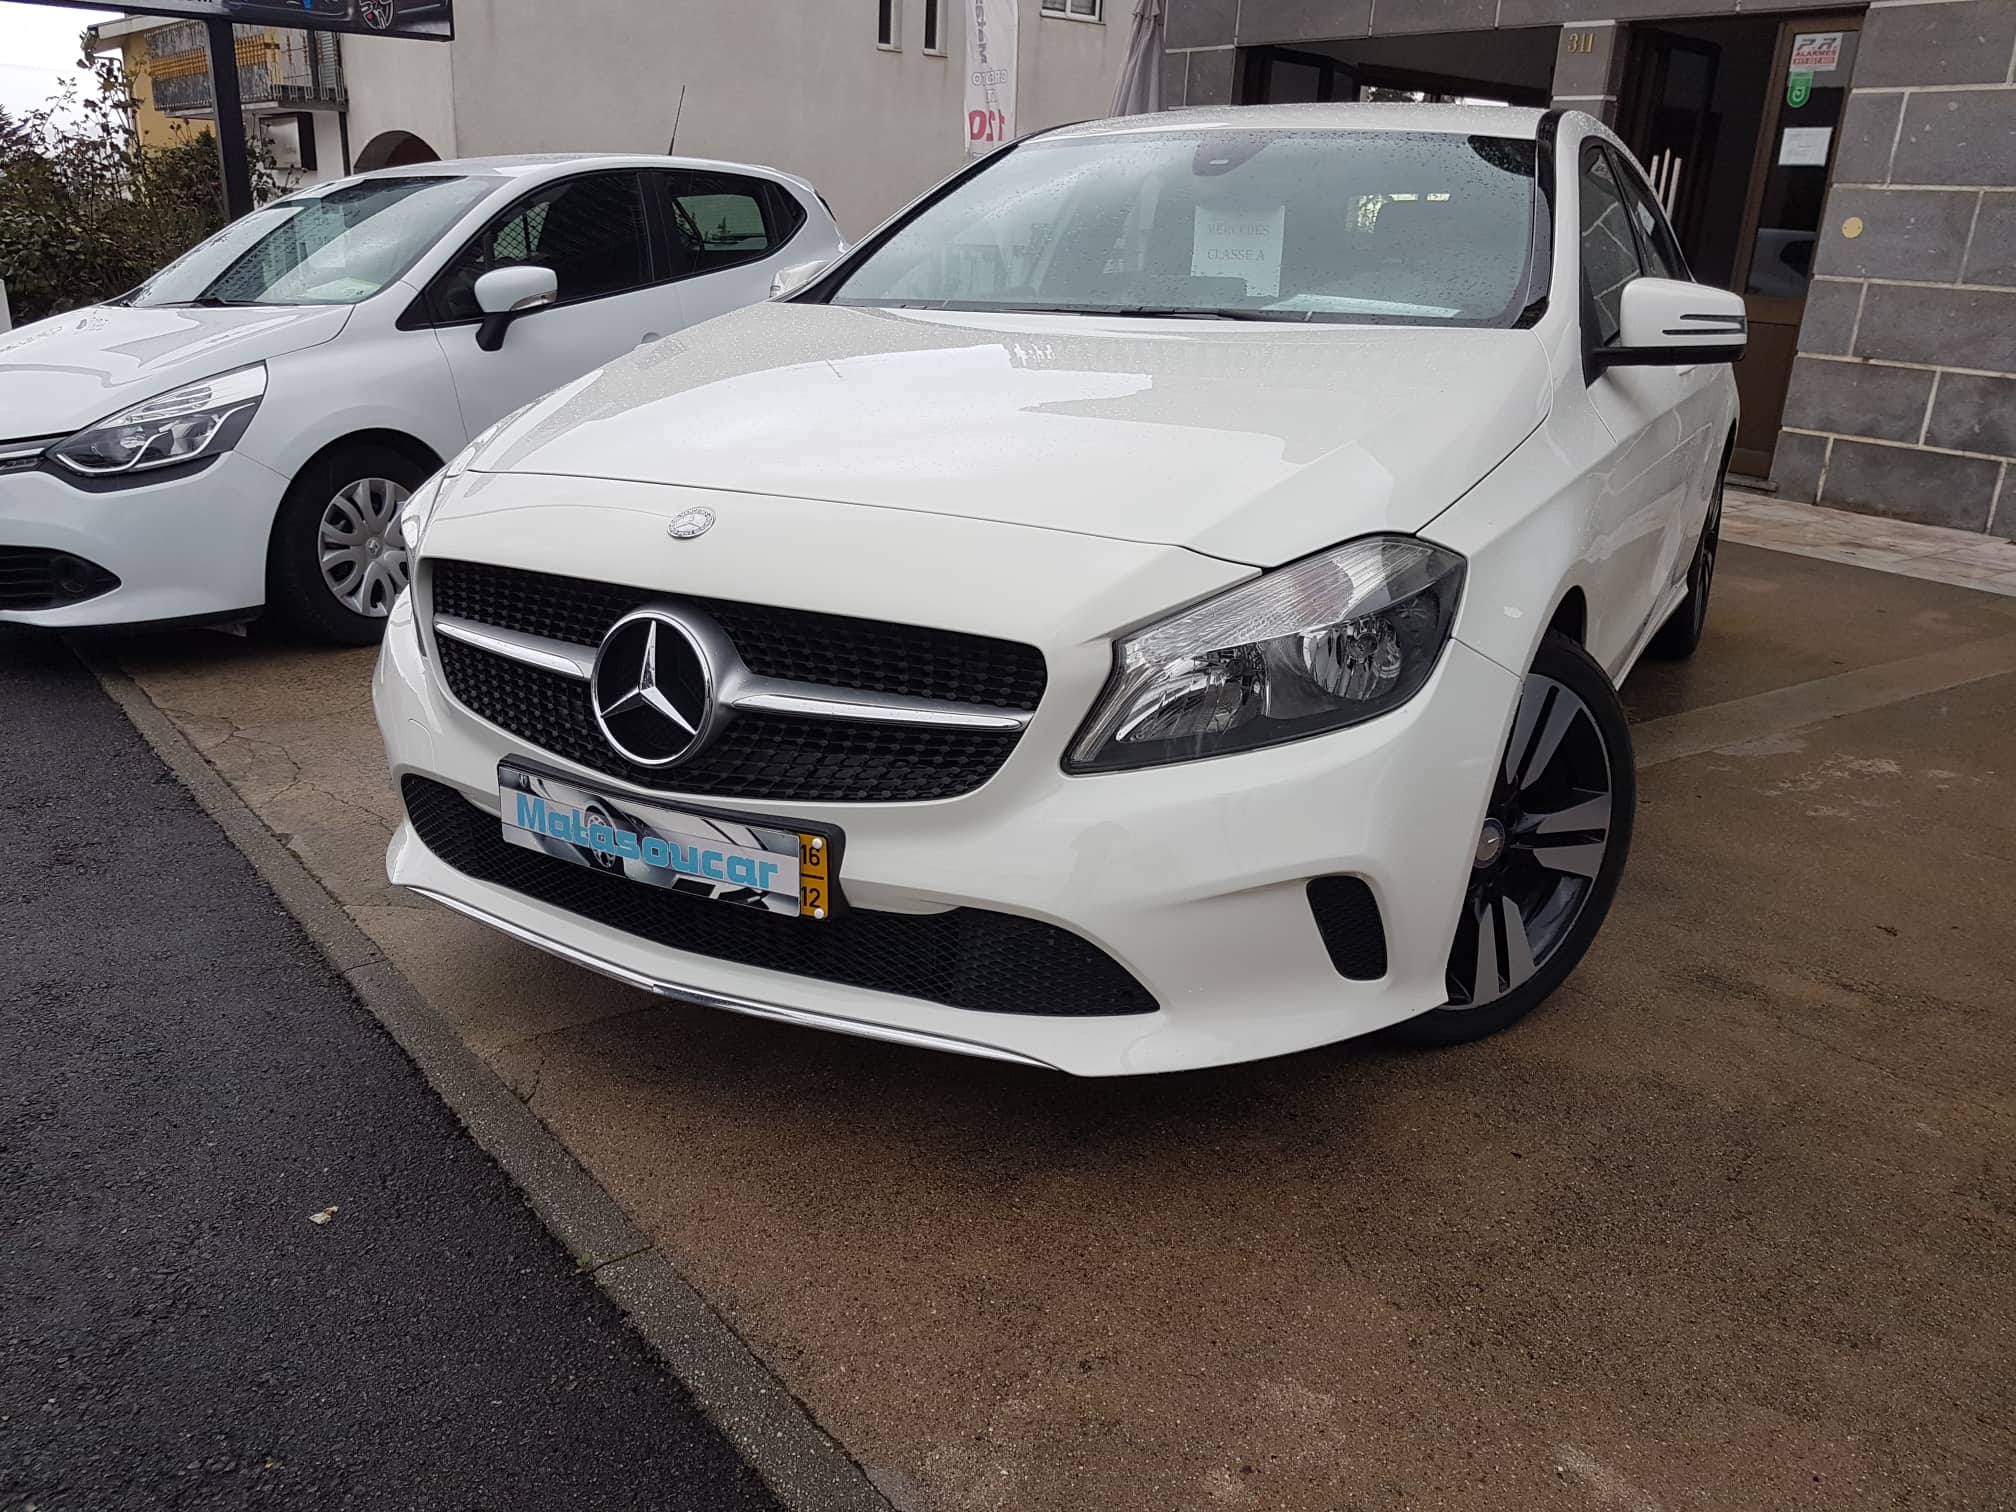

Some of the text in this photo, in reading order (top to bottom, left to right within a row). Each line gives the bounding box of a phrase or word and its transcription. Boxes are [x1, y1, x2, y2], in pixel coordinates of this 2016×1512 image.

[1568, 32, 1594, 55] 311
[1794, 49, 1837, 58] ALARMES
[515, 792, 779, 889] Matasoucar
[801, 844, 821, 867] 16
[801, 885, 821, 909] 12
